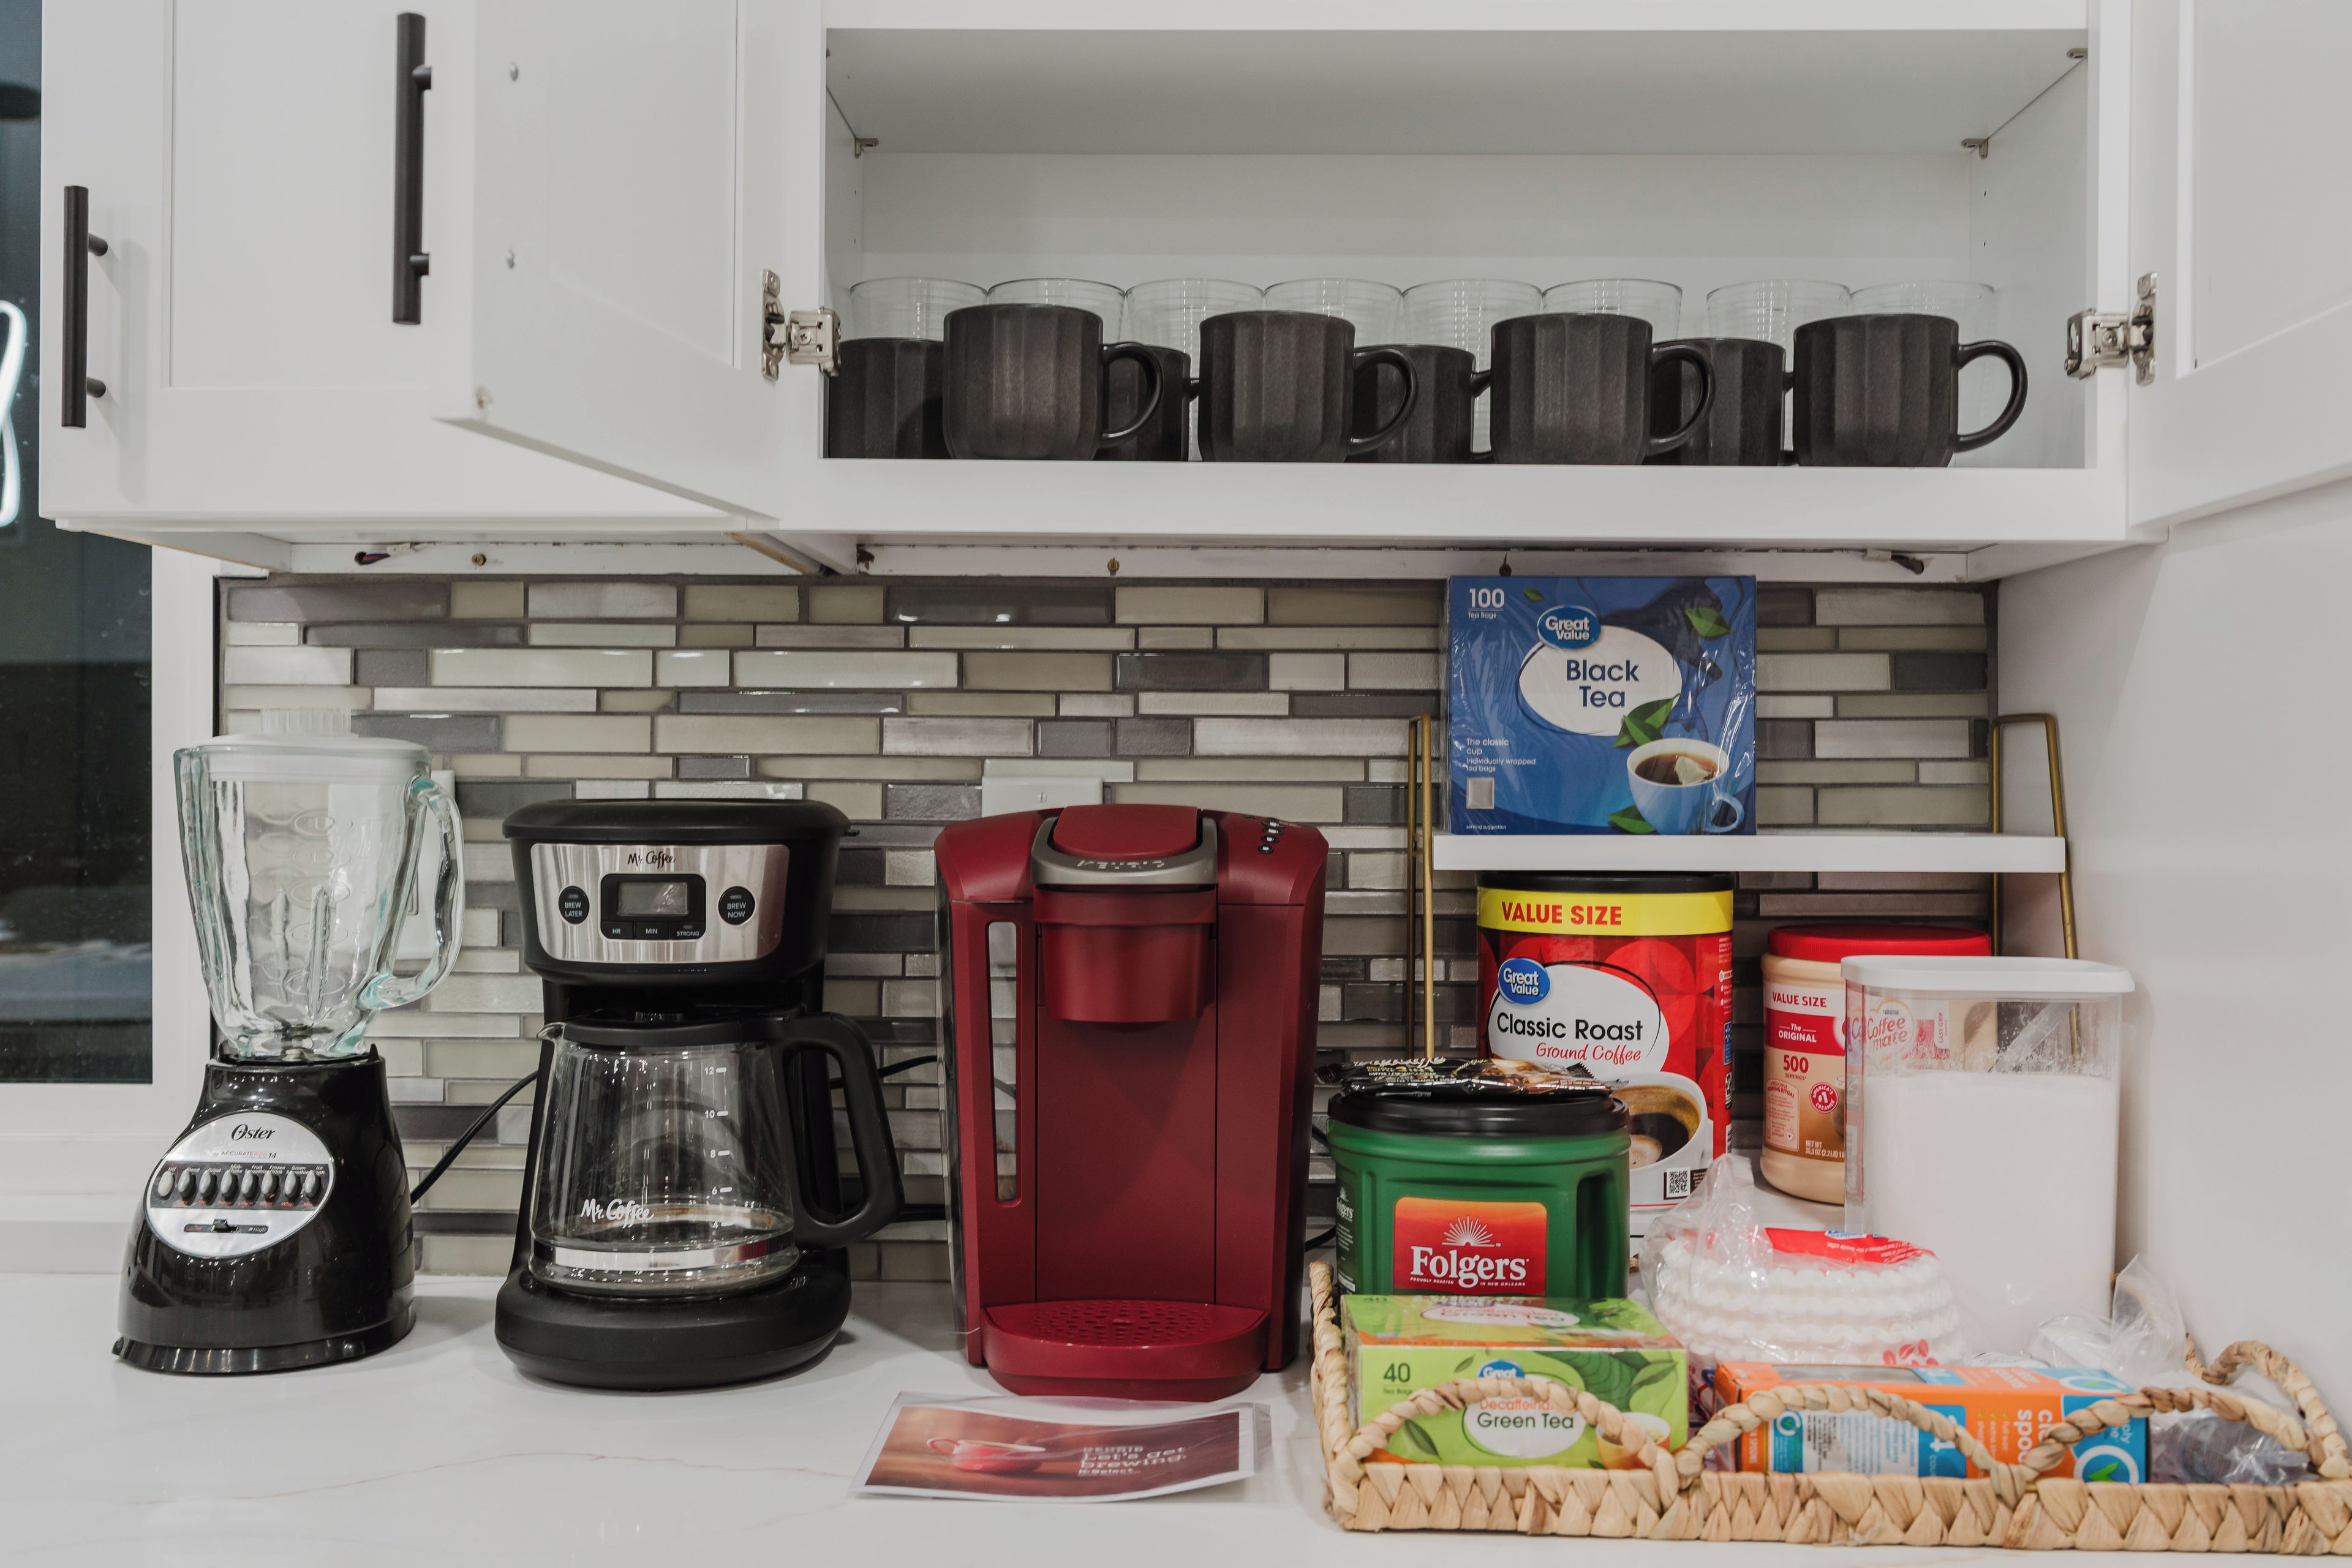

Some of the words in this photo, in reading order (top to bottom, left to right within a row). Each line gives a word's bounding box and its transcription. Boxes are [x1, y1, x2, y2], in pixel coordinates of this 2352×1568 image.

[1469, 588, 1505, 608] 100
[1545, 616, 1590, 631] Great
[1556, 630, 1590, 641] Value
[1566, 659, 1640, 682] Black
[1578, 685, 1625, 708] Tea
[1466, 737, 1480, 746] The
[1482, 737, 1509, 746] classic
[1466, 747, 1483, 756] cup
[1466, 757, 1504, 766] Individually
[627, 853, 644, 865] Mr.
[645, 850, 676, 869] Coffee
[726, 902, 747, 910] BREW
[727, 910, 745, 919] NOW
[1502, 902, 1562, 924] VALUE
[1570, 905, 1623, 925] SIZE
[1502, 966, 1540, 987] Great
[1510, 982, 1539, 996] Value
[1772, 992, 1800, 1005] VALUE
[1802, 996, 1827, 1008] SIZE
[1496, 1012, 1567, 1039] Classic
[1575, 1019, 1643, 1041] Roast
[1790, 1023, 1801, 1031] The
[1868, 1017, 1906, 1040] Coffee
[1778, 1030, 1817, 1043] ORIGINAL
[1872, 1030, 1909, 1050] mate
[1536, 1043, 1588, 1061] Ground
[1592, 1044, 1642, 1065] Coffee
[704, 1066, 715, 1076] 12
[1783, 1054, 1809, 1074] 500
[1781, 1088, 1795, 1098] RITUAL
[704, 1109, 715, 1118] 10
[231, 1123, 276, 1141] Oster
[1806, 1139, 1814, 1148] NET
[1814, 1140, 1822, 1149] WT
[710, 1149, 716, 1158] 8
[711, 1186, 718, 1195] 6
[581, 1198, 605, 1223] Mr.
[606, 1198, 655, 1229] Coffee
[1410, 1245, 1529, 1289] Folgers
[1383, 1363, 1411, 1383] 40
[1482, 1366, 1518, 1378] Great
[1480, 1397, 1554, 1411] Decaffeina
[1477, 1412, 1536, 1428] Green
[1541, 1413, 1574, 1429] Tea
[1080, 1455, 1187, 1469] brewing.
[1084, 1452, 1139, 1460] Let's
